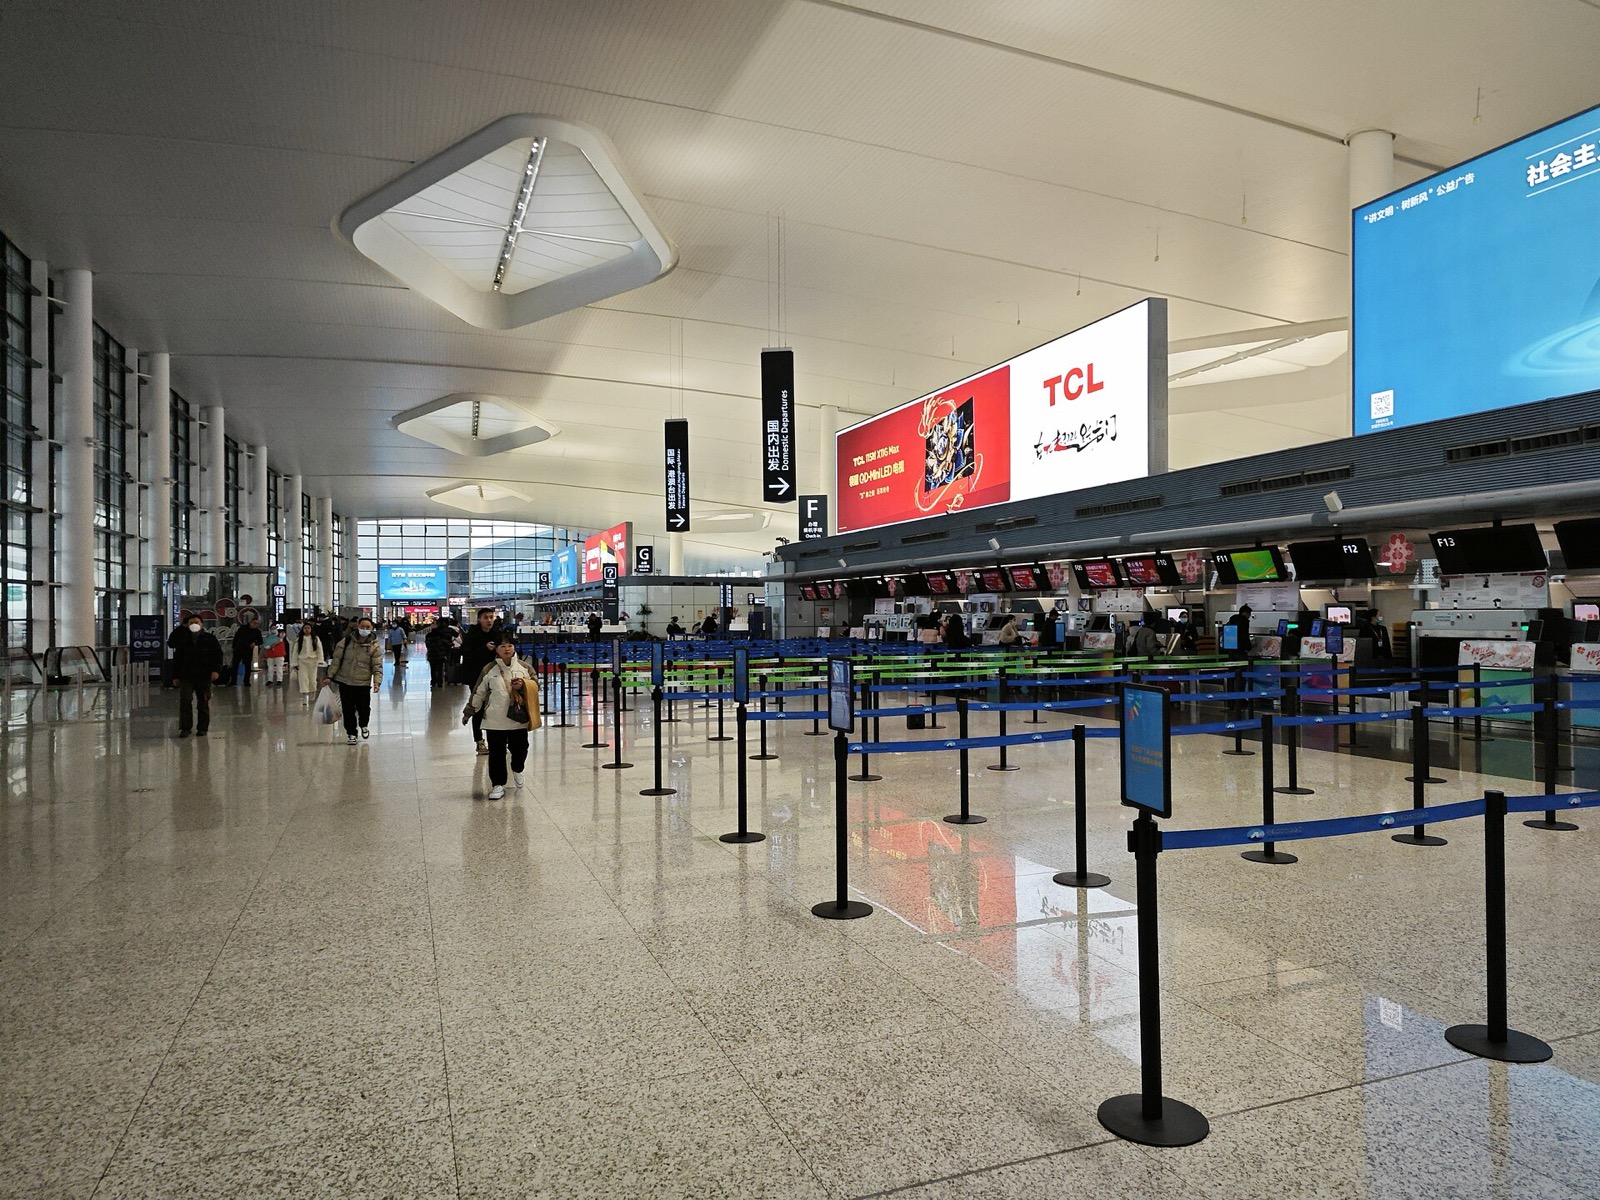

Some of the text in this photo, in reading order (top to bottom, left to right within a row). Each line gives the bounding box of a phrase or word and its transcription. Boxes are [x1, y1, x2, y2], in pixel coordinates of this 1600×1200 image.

[1527, 139, 1600, 187] 社会主
[1043, 363, 1104, 407] TCL
[781, 389, 789, 471] Domestic Departures
[767, 420, 780, 471] 国内出发
[853, 455, 865, 467] TCL
[807, 500, 818, 518] F
[1437, 537, 1456, 547] F13
[639, 548, 649, 560] G
[1343, 544, 1359, 554] F12
[1216, 555, 1228, 563] F11
[540, 573, 548, 581] G
